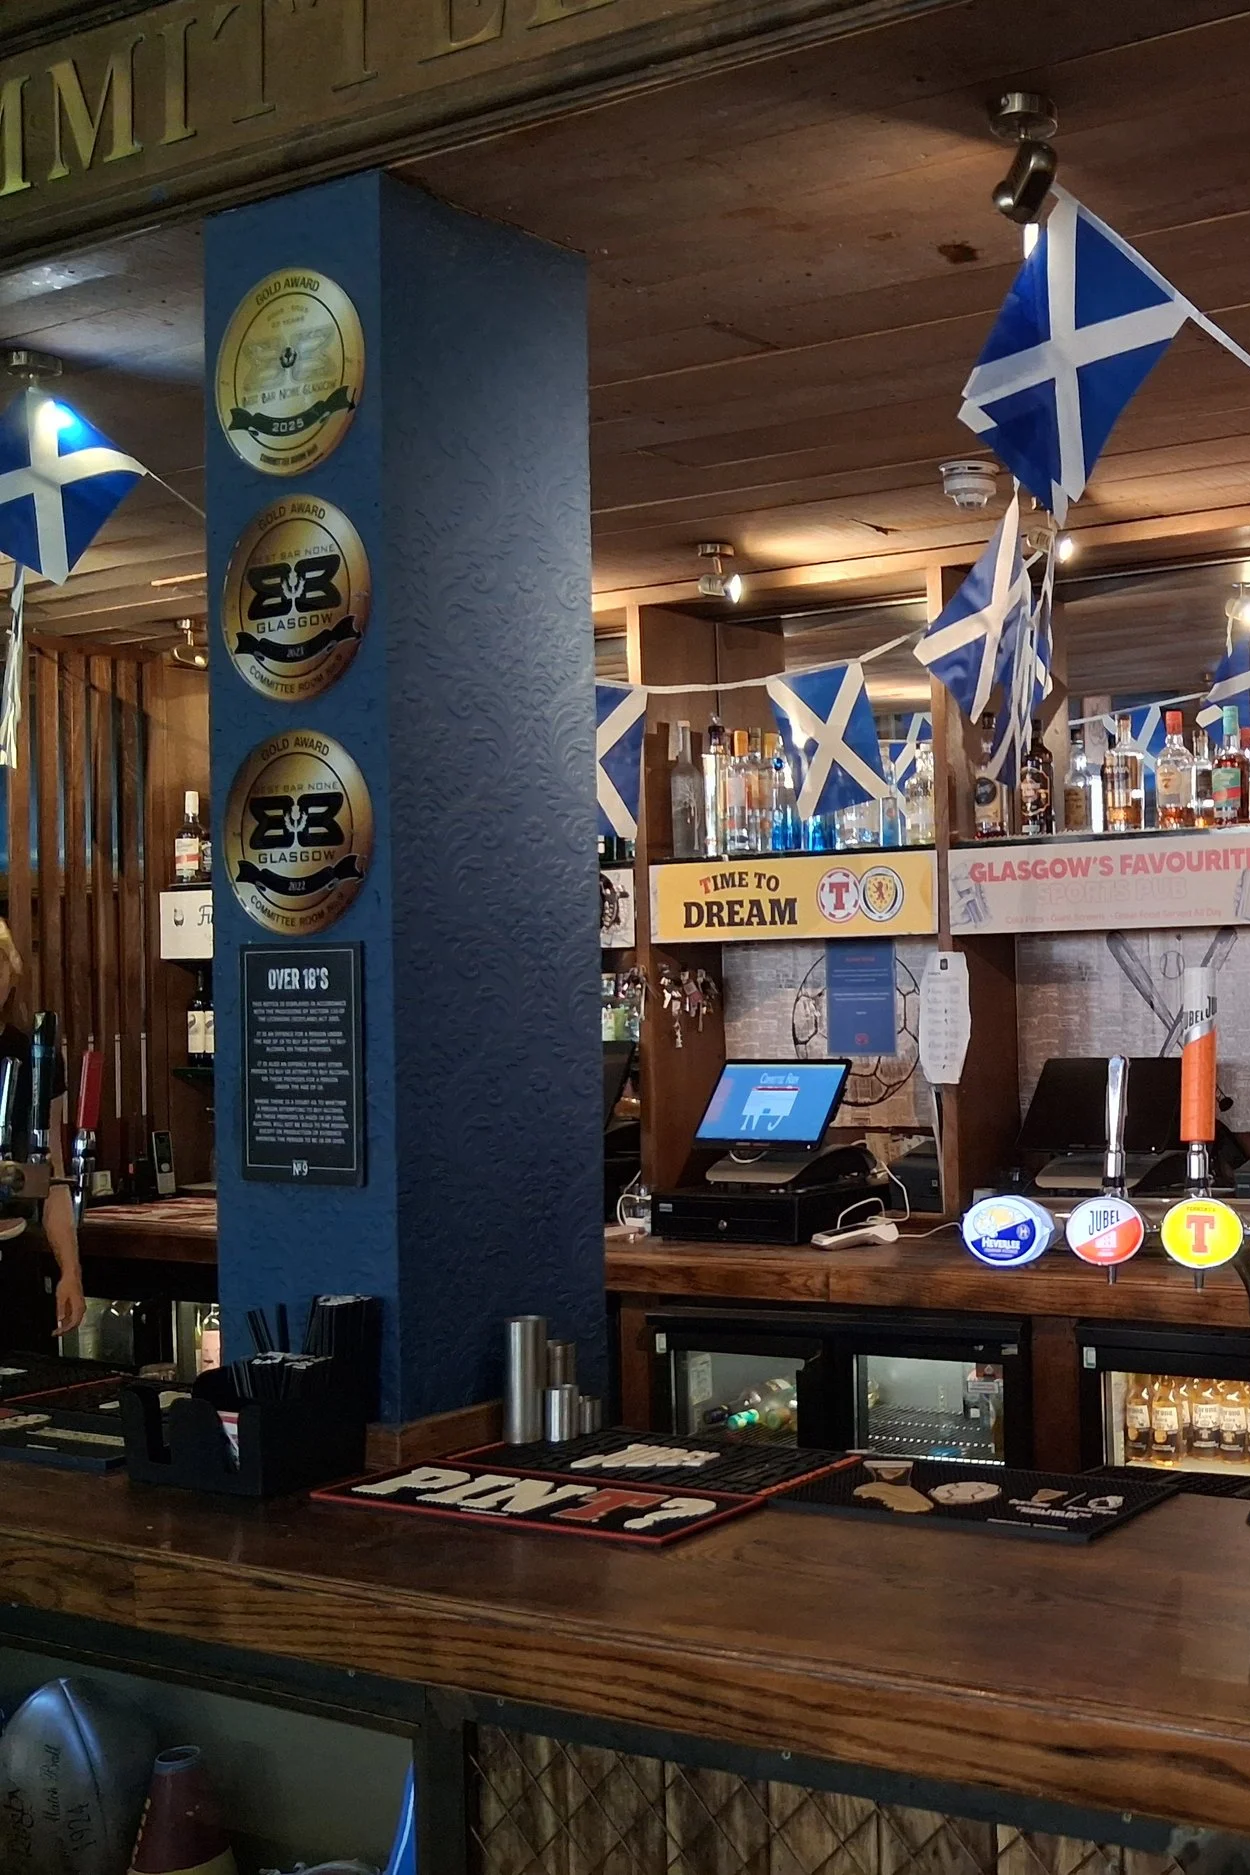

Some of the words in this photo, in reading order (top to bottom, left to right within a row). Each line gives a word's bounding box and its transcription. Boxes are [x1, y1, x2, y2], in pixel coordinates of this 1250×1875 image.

[256, 281, 281, 305] GOLD
[284, 277, 320, 292] AWARD
[272, 420, 304, 432] 2025
[258, 507, 286, 531] GOLD
[290, 503, 325, 520] AWARD
[304, 544, 335, 557] NONE
[257, 613, 333, 634] GLASGOW
[250, 666, 295, 694] COMMITTEE
[261, 738, 289, 761] GOLD
[294, 736, 330, 756] AWARD
[283, 784, 303, 793] BAR
[308, 781, 339, 791] NONE
[258, 851, 335, 864] GLASGOW
[969, 854, 1114, 885] GLASGOW'S
[700, 871, 749, 895] TIME
[754, 872, 780, 893] TO
[1037, 877, 1130, 904] SPORTS
[1135, 876, 1188, 901] PUB
[250, 895, 296, 927] COMMITTEE
[683, 898, 798, 929] DREAM
[268, 967, 300, 990] OVER
[303, 966, 329, 990] 18'S
[1089, 1210, 1120, 1235] JUBEL
[1186, 1215, 1215, 1253] T
[351, 1466, 717, 1530] PINT?
